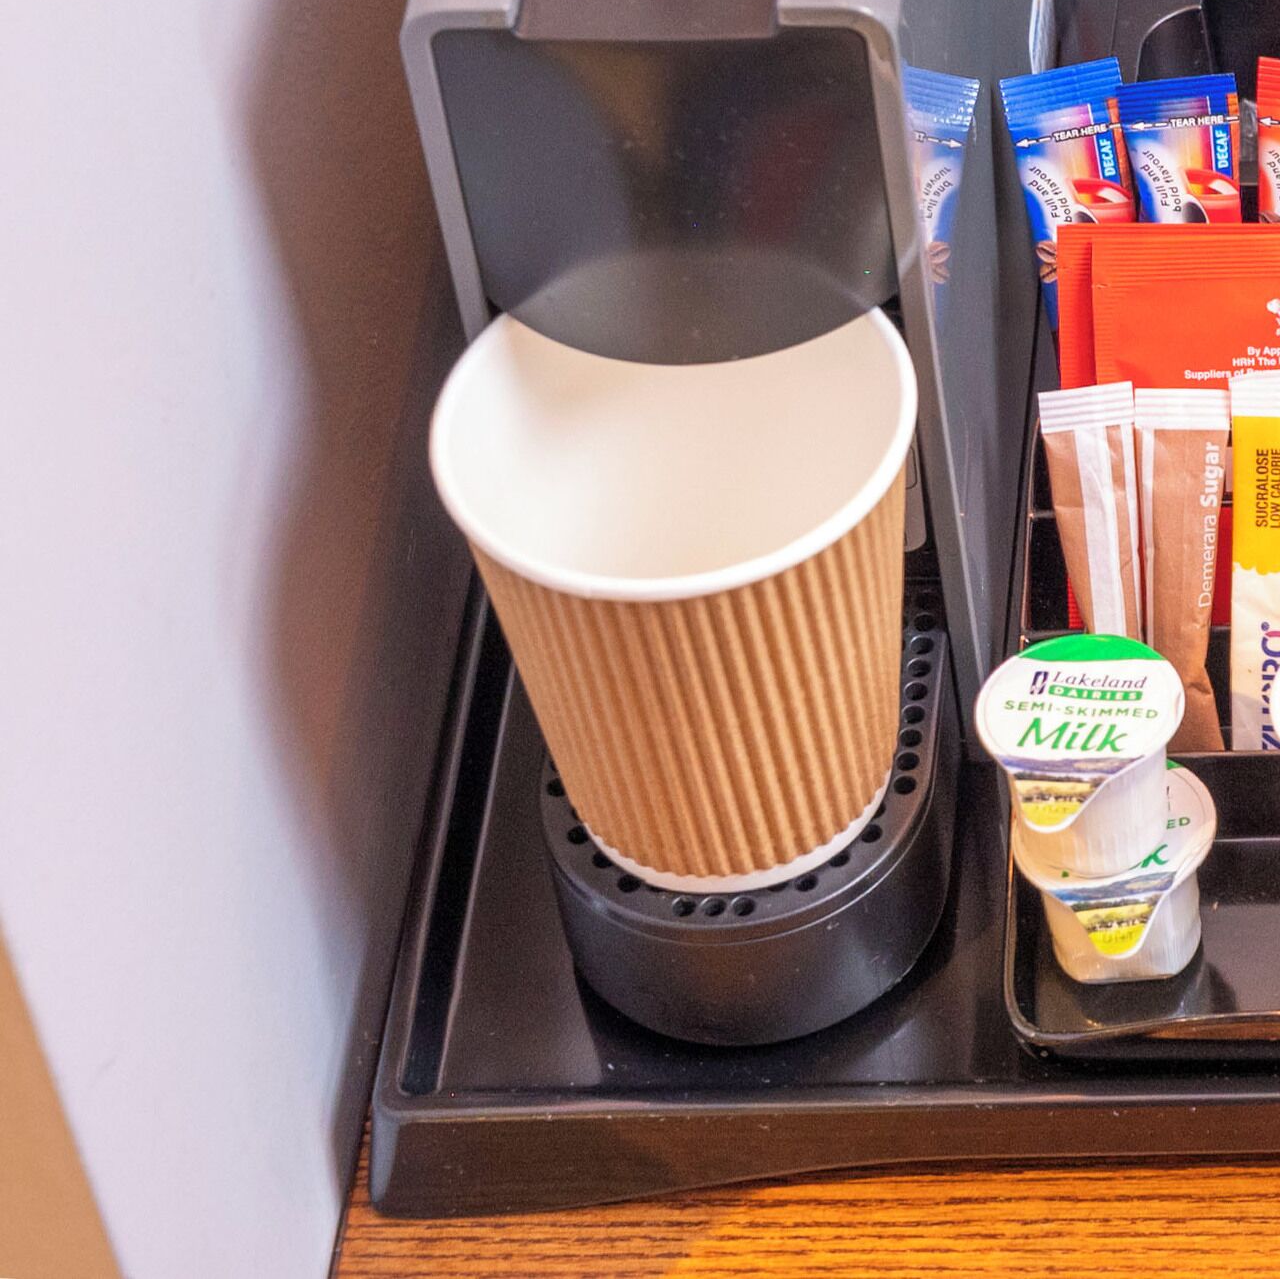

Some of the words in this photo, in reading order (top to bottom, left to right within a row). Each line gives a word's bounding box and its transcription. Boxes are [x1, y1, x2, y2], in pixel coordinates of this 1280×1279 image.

[1169, 118, 1196, 128] TEAR
[1197, 115, 1224, 125] HERE
[1053, 130, 1079, 141] TEAR
[1081, 124, 1107, 136] HERE
[1099, 139, 1116, 177] DECAF
[1215, 129, 1228, 169] DECAF
[1140, 164, 1160, 182] and
[1028, 180, 1049, 197] and
[1155, 185, 1170, 207] Full
[1044, 198, 1060, 218] Full
[1169, 187, 1182, 212] bold
[1058, 198, 1072, 222] bold
[1247, 346, 1260, 356] By
[1232, 358, 1256, 367] HRH
[1258, 357, 1276, 366] The
[1184, 369, 1232, 380] Suppliers
[1200, 441, 1224, 508] Sugar
[1256, 449, 1269, 528] SUCRALOSE
[1198, 515, 1217, 608] Demerara
[1052, 671, 1148, 689] Lakeland
[1053, 686, 1138, 700] DAIRIES
[1004, 700, 1159, 719] SEMI-SKIMMED
[1016, 717, 1128, 752] Milk
